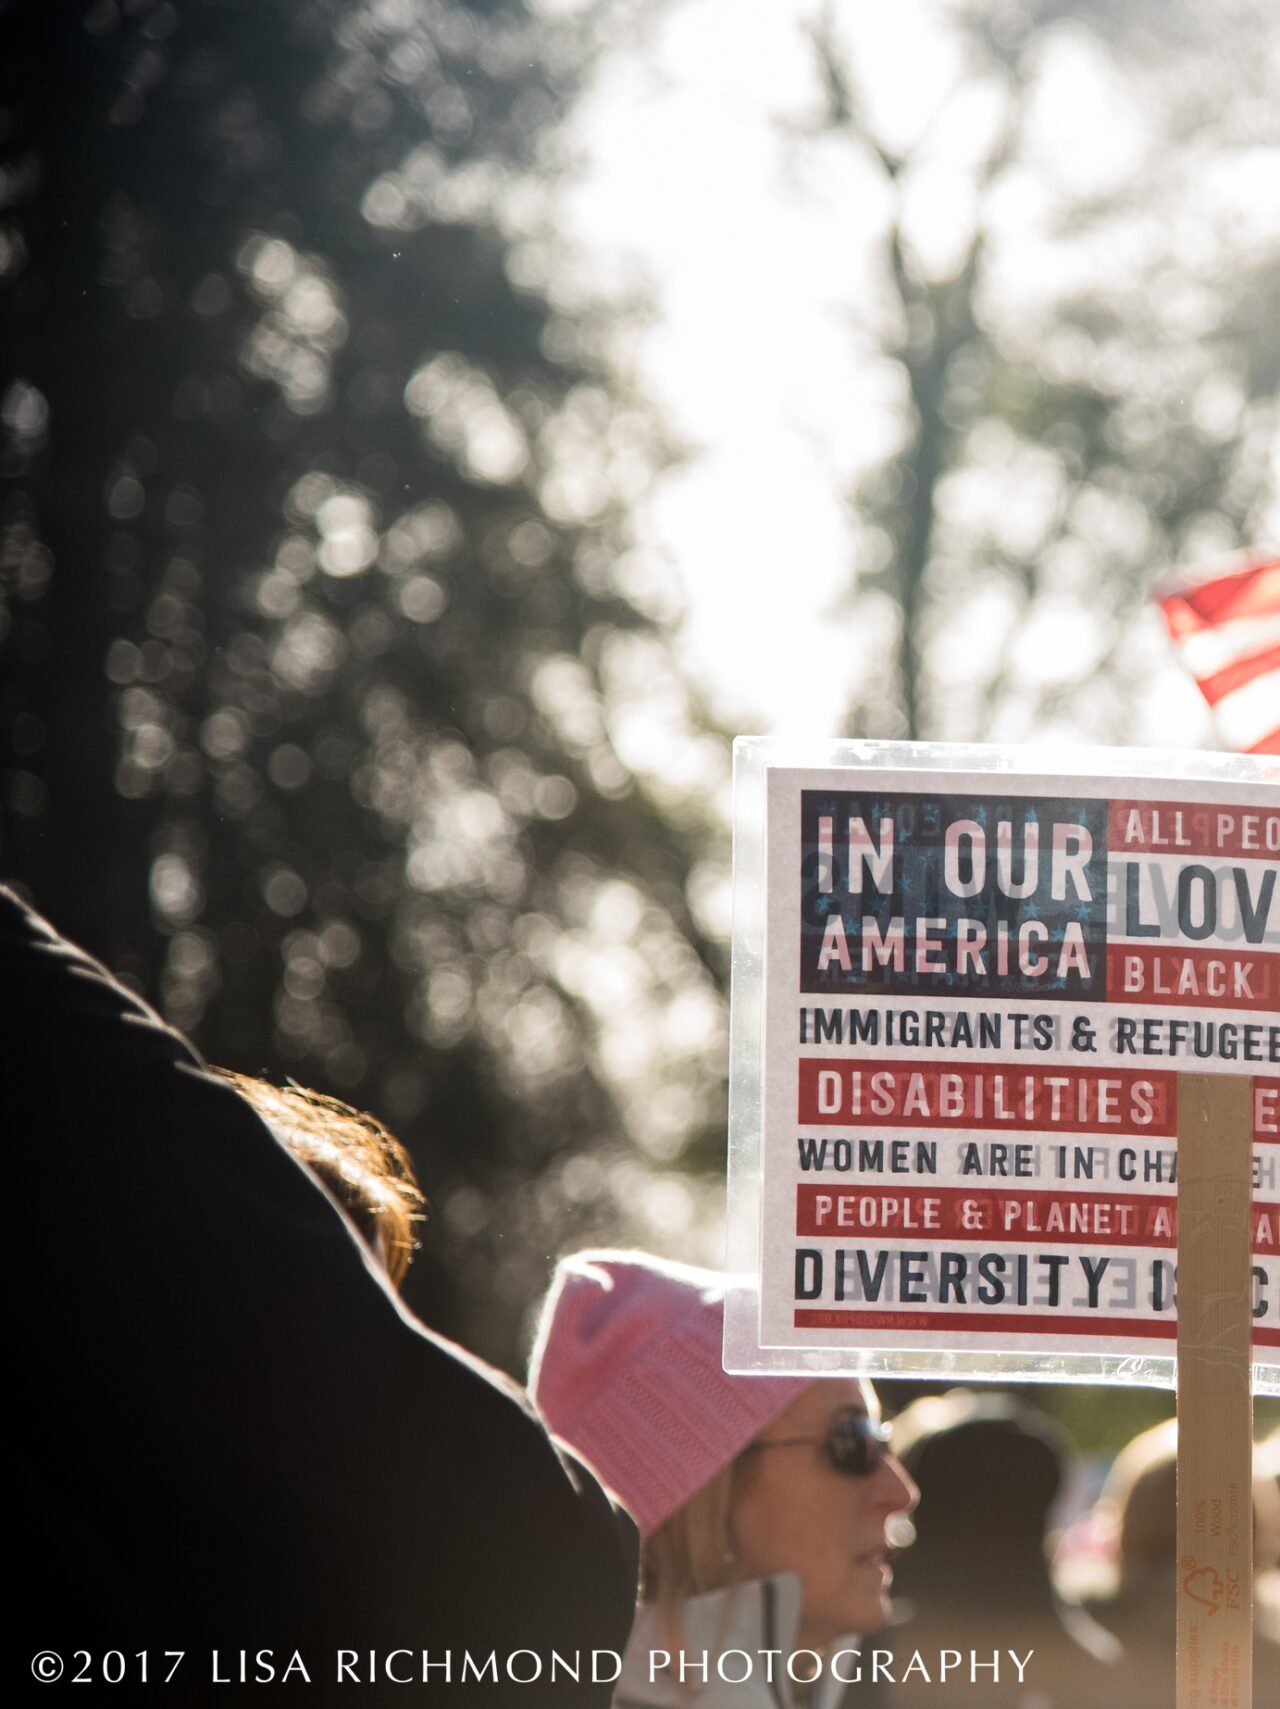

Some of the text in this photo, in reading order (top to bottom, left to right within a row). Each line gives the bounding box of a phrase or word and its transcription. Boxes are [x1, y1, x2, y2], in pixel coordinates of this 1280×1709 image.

[1124, 808, 1192, 847] ALL
[817, 816, 1093, 902] IN OUR
[816, 914, 1092, 979] AMERICA
[1124, 955, 1256, 1000] BLACK
[799, 1007, 1054, 1052] IMMIGRANTS
[1071, 1016, 1098, 1053] &
[817, 1070, 1156, 1125] DISABILITIES
[798, 1138, 937, 1175] WOMEN
[963, 1142, 1034, 1178] ARE
[1059, 1145, 1094, 1180] IN
[815, 1195, 941, 1230] PEOPLE
[961, 1199, 984, 1231] &
[1004, 1200, 1134, 1236] PLANET
[794, 1248, 1111, 1309] DIVERSITY
[1210, 1498, 1222, 1537] Wood
[1225, 1568, 1240, 1610] FSC
